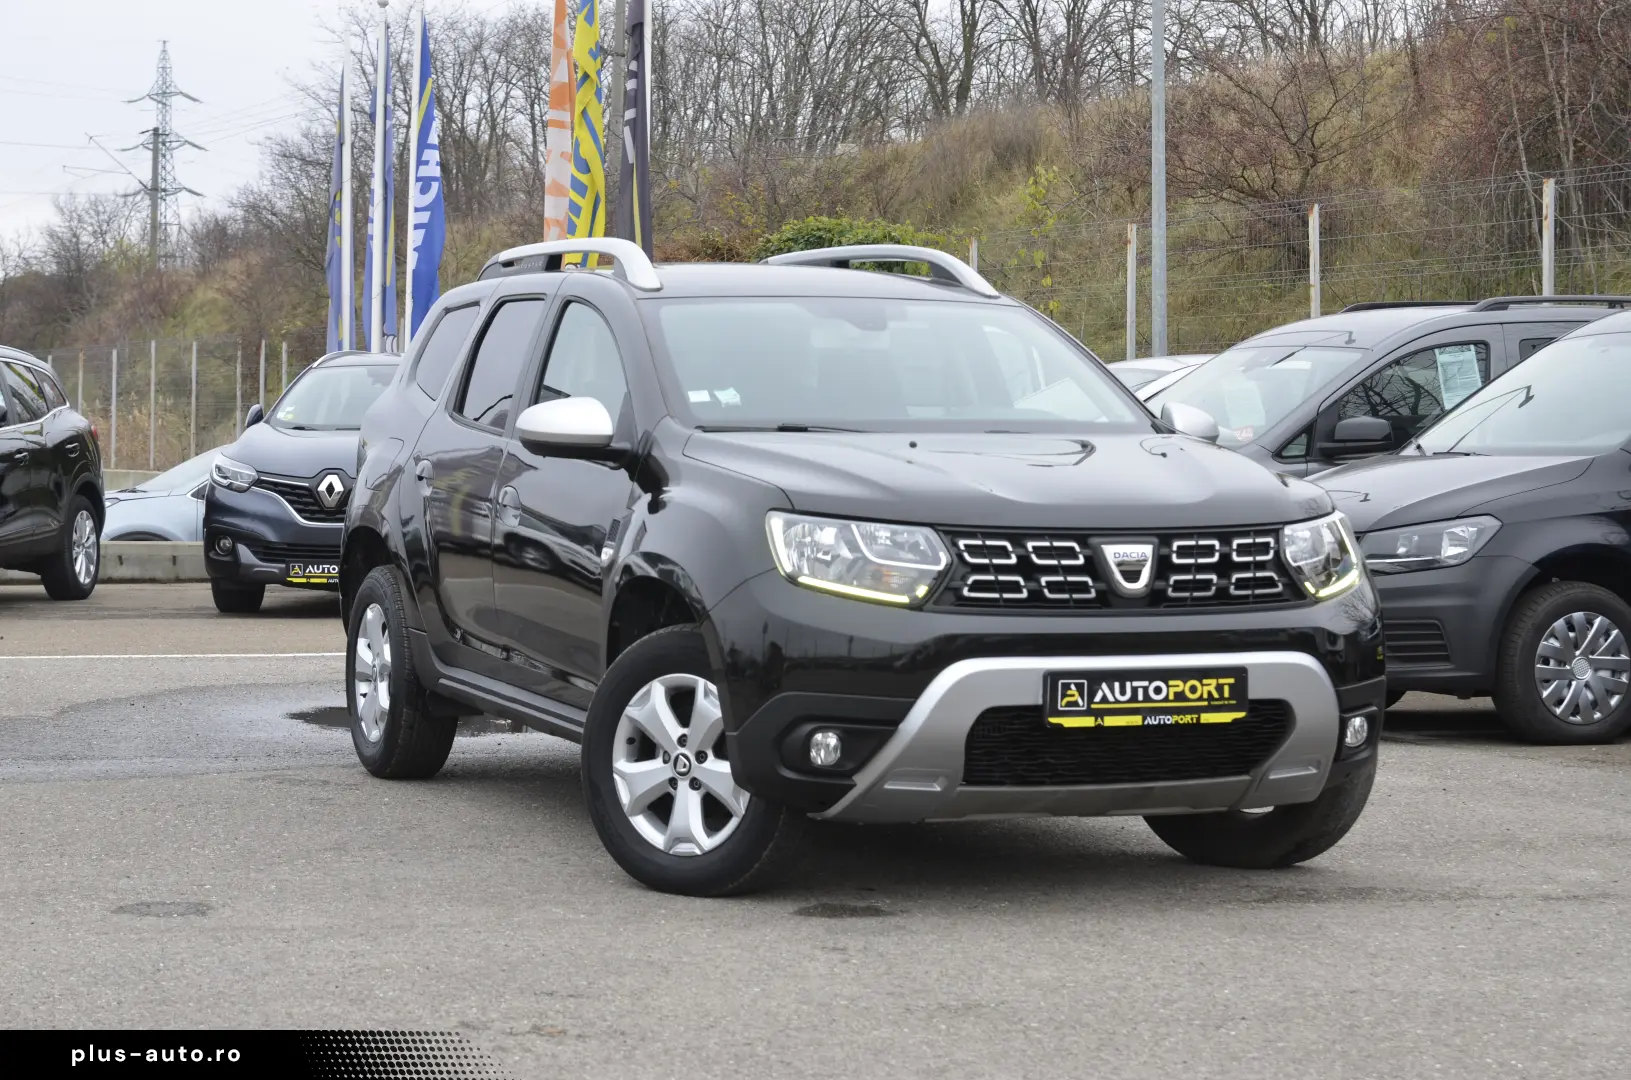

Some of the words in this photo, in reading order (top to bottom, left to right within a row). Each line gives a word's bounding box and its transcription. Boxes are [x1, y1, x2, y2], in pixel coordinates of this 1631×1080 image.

[1113, 551, 1149, 559] DACIA
[306, 564, 339, 574] AUTO
[1093, 678, 1235, 703] AUTOPORT
[1144, 714, 1199, 726] AUTOPORT
